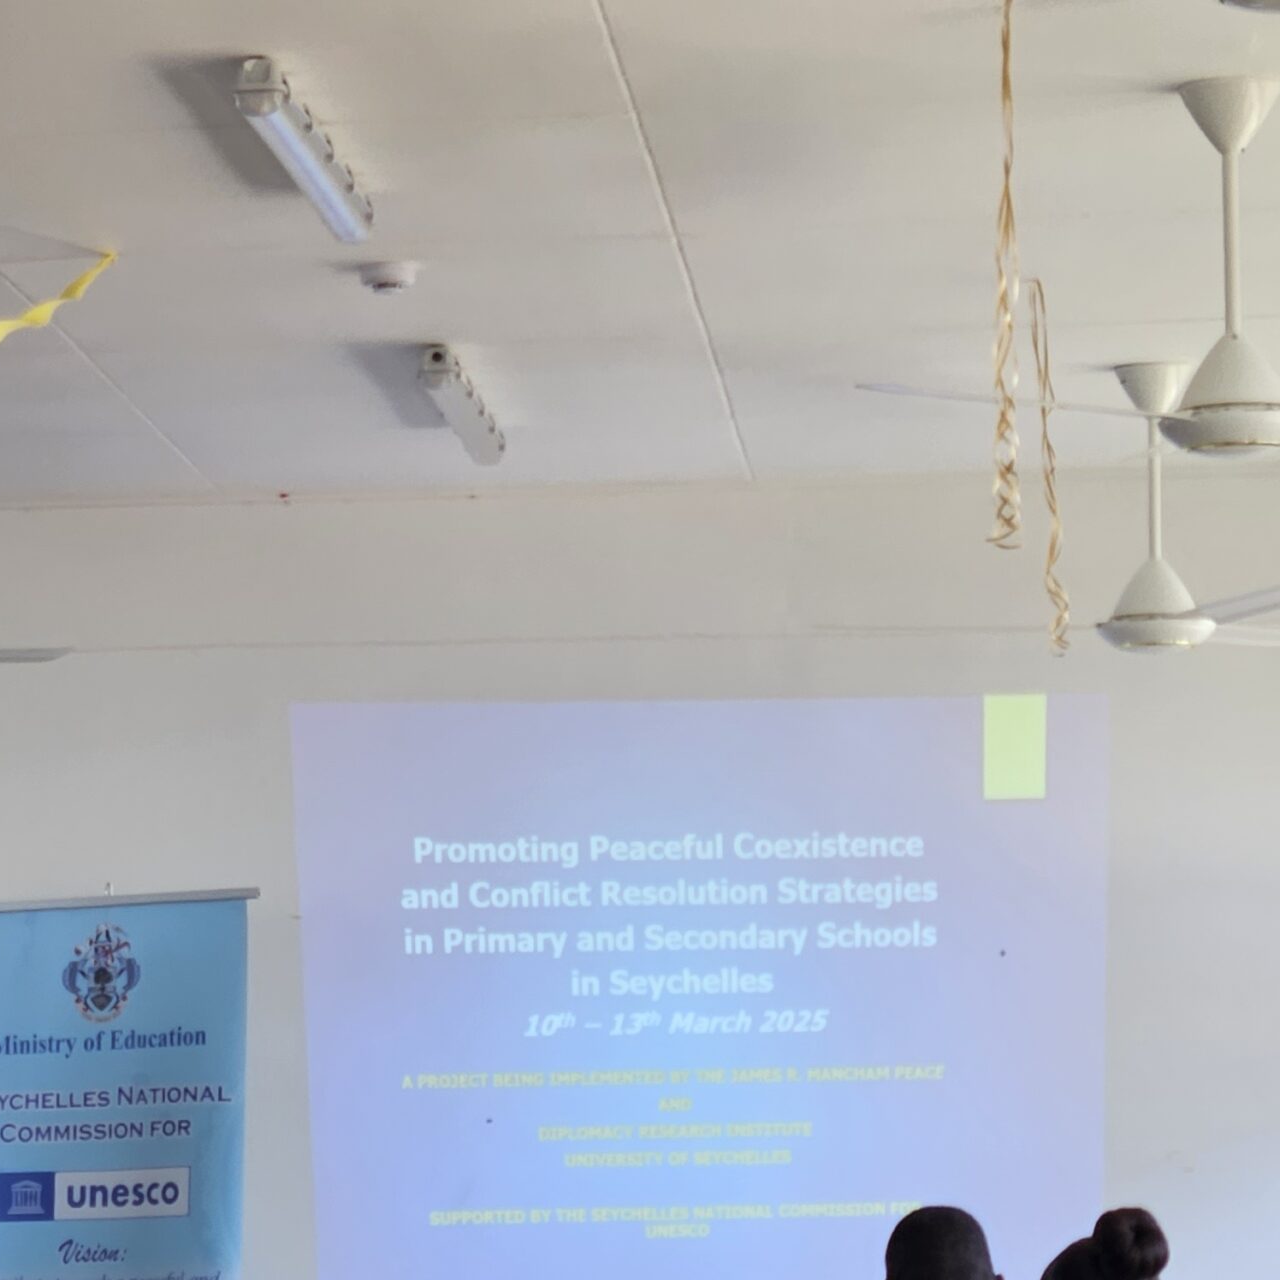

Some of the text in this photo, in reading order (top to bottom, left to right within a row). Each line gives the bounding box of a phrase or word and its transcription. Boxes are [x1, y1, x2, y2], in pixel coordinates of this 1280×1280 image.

[413, 830, 925, 868] Promoting Peaceful Coexistence
[401, 875, 938, 909] and Conflict Resolution Strategies
[404, 920, 938, 959] in Primary and Secondary Schools
[571, 967, 774, 1002] in Seychelles
[524, 1012, 576, 1037] 10th
[609, 1010, 662, 1036] 13th
[668, 1009, 752, 1034] March
[759, 1008, 830, 1033] 2025
[84, 1030, 105, 1051] of
[110, 1026, 206, 1049] Education
[401, 1075, 414, 1089] A
[418, 1073, 488, 1089] PROJECT
[895, 1065, 945, 1080] PEACE
[117, 1086, 232, 1106] NATIONAL
[0, 1120, 191, 1143] COMMISSION FOR
[66, 1182, 179, 1208] unesco
[429, 1209, 526, 1226] SUPPORTED
[58, 1239, 128, 1264] Vision:
